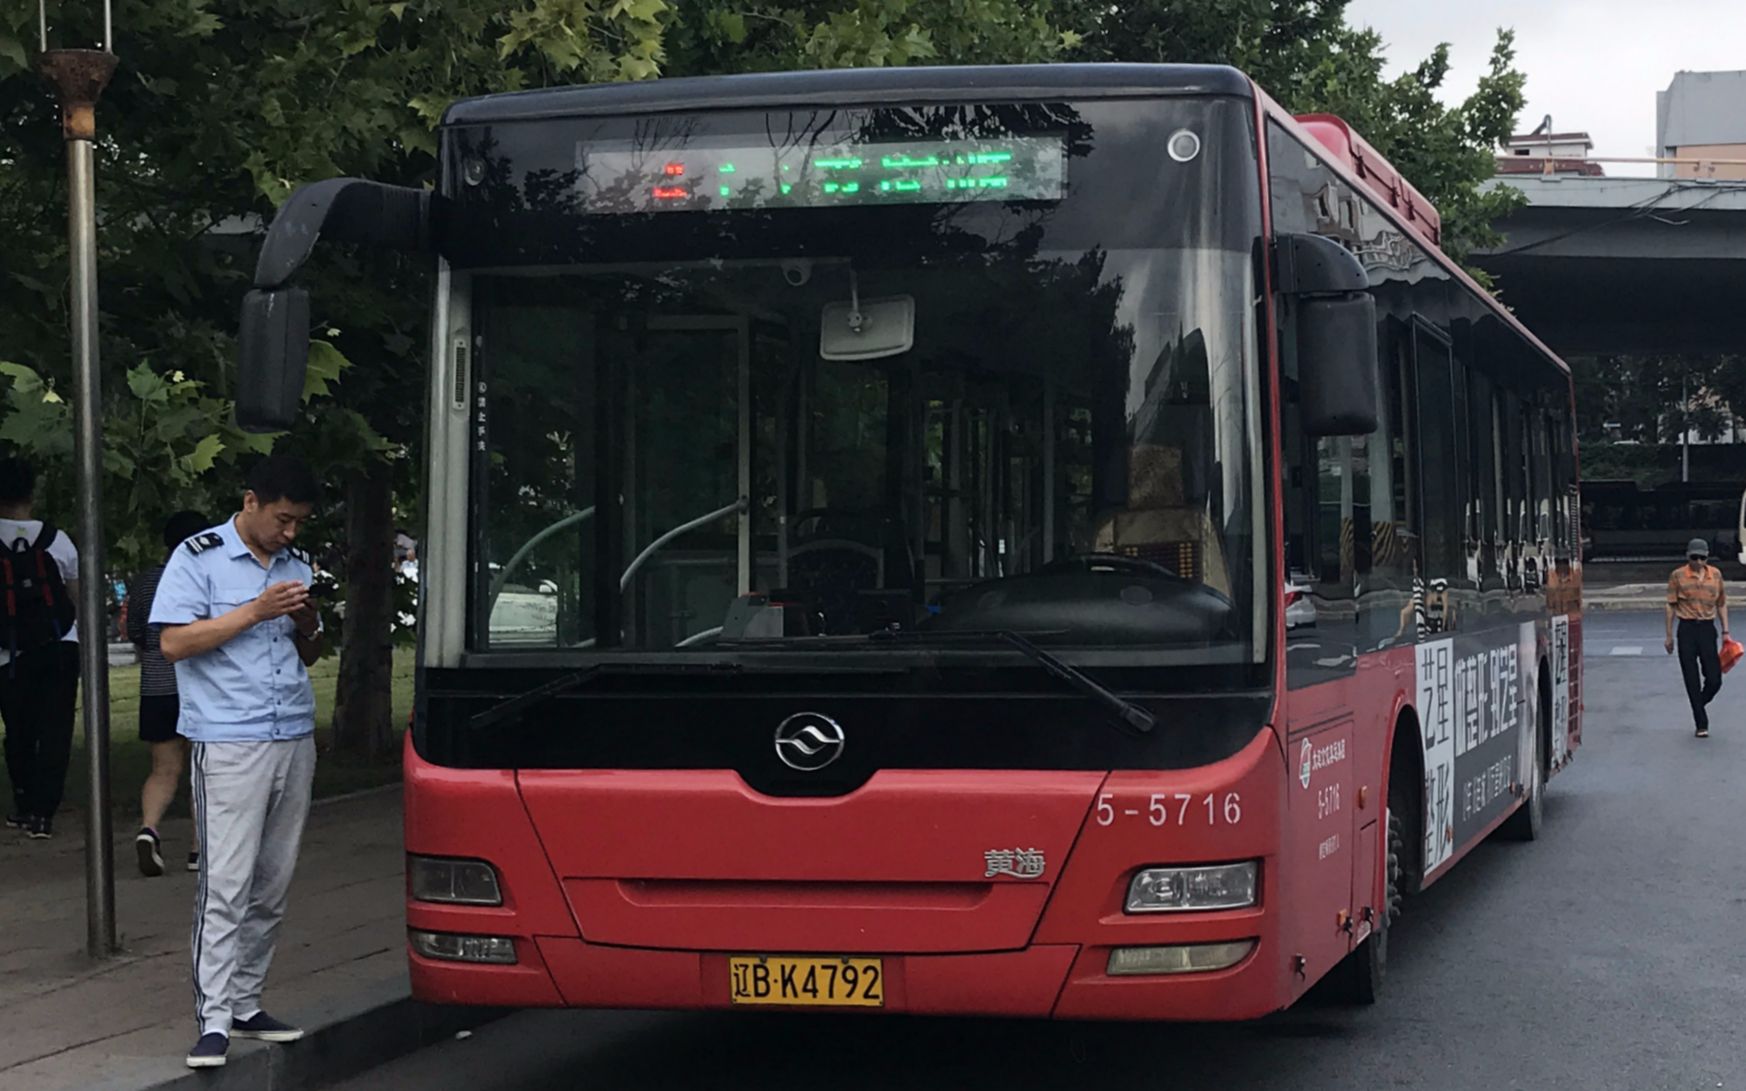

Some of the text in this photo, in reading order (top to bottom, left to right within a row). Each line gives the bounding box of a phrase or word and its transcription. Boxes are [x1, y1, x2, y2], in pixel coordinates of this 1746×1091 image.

[1096, 792, 1242, 826] 5-5716
[984, 847, 1046, 879] 黄海
[733, 964, 881, 1000] 辽B·K4792
